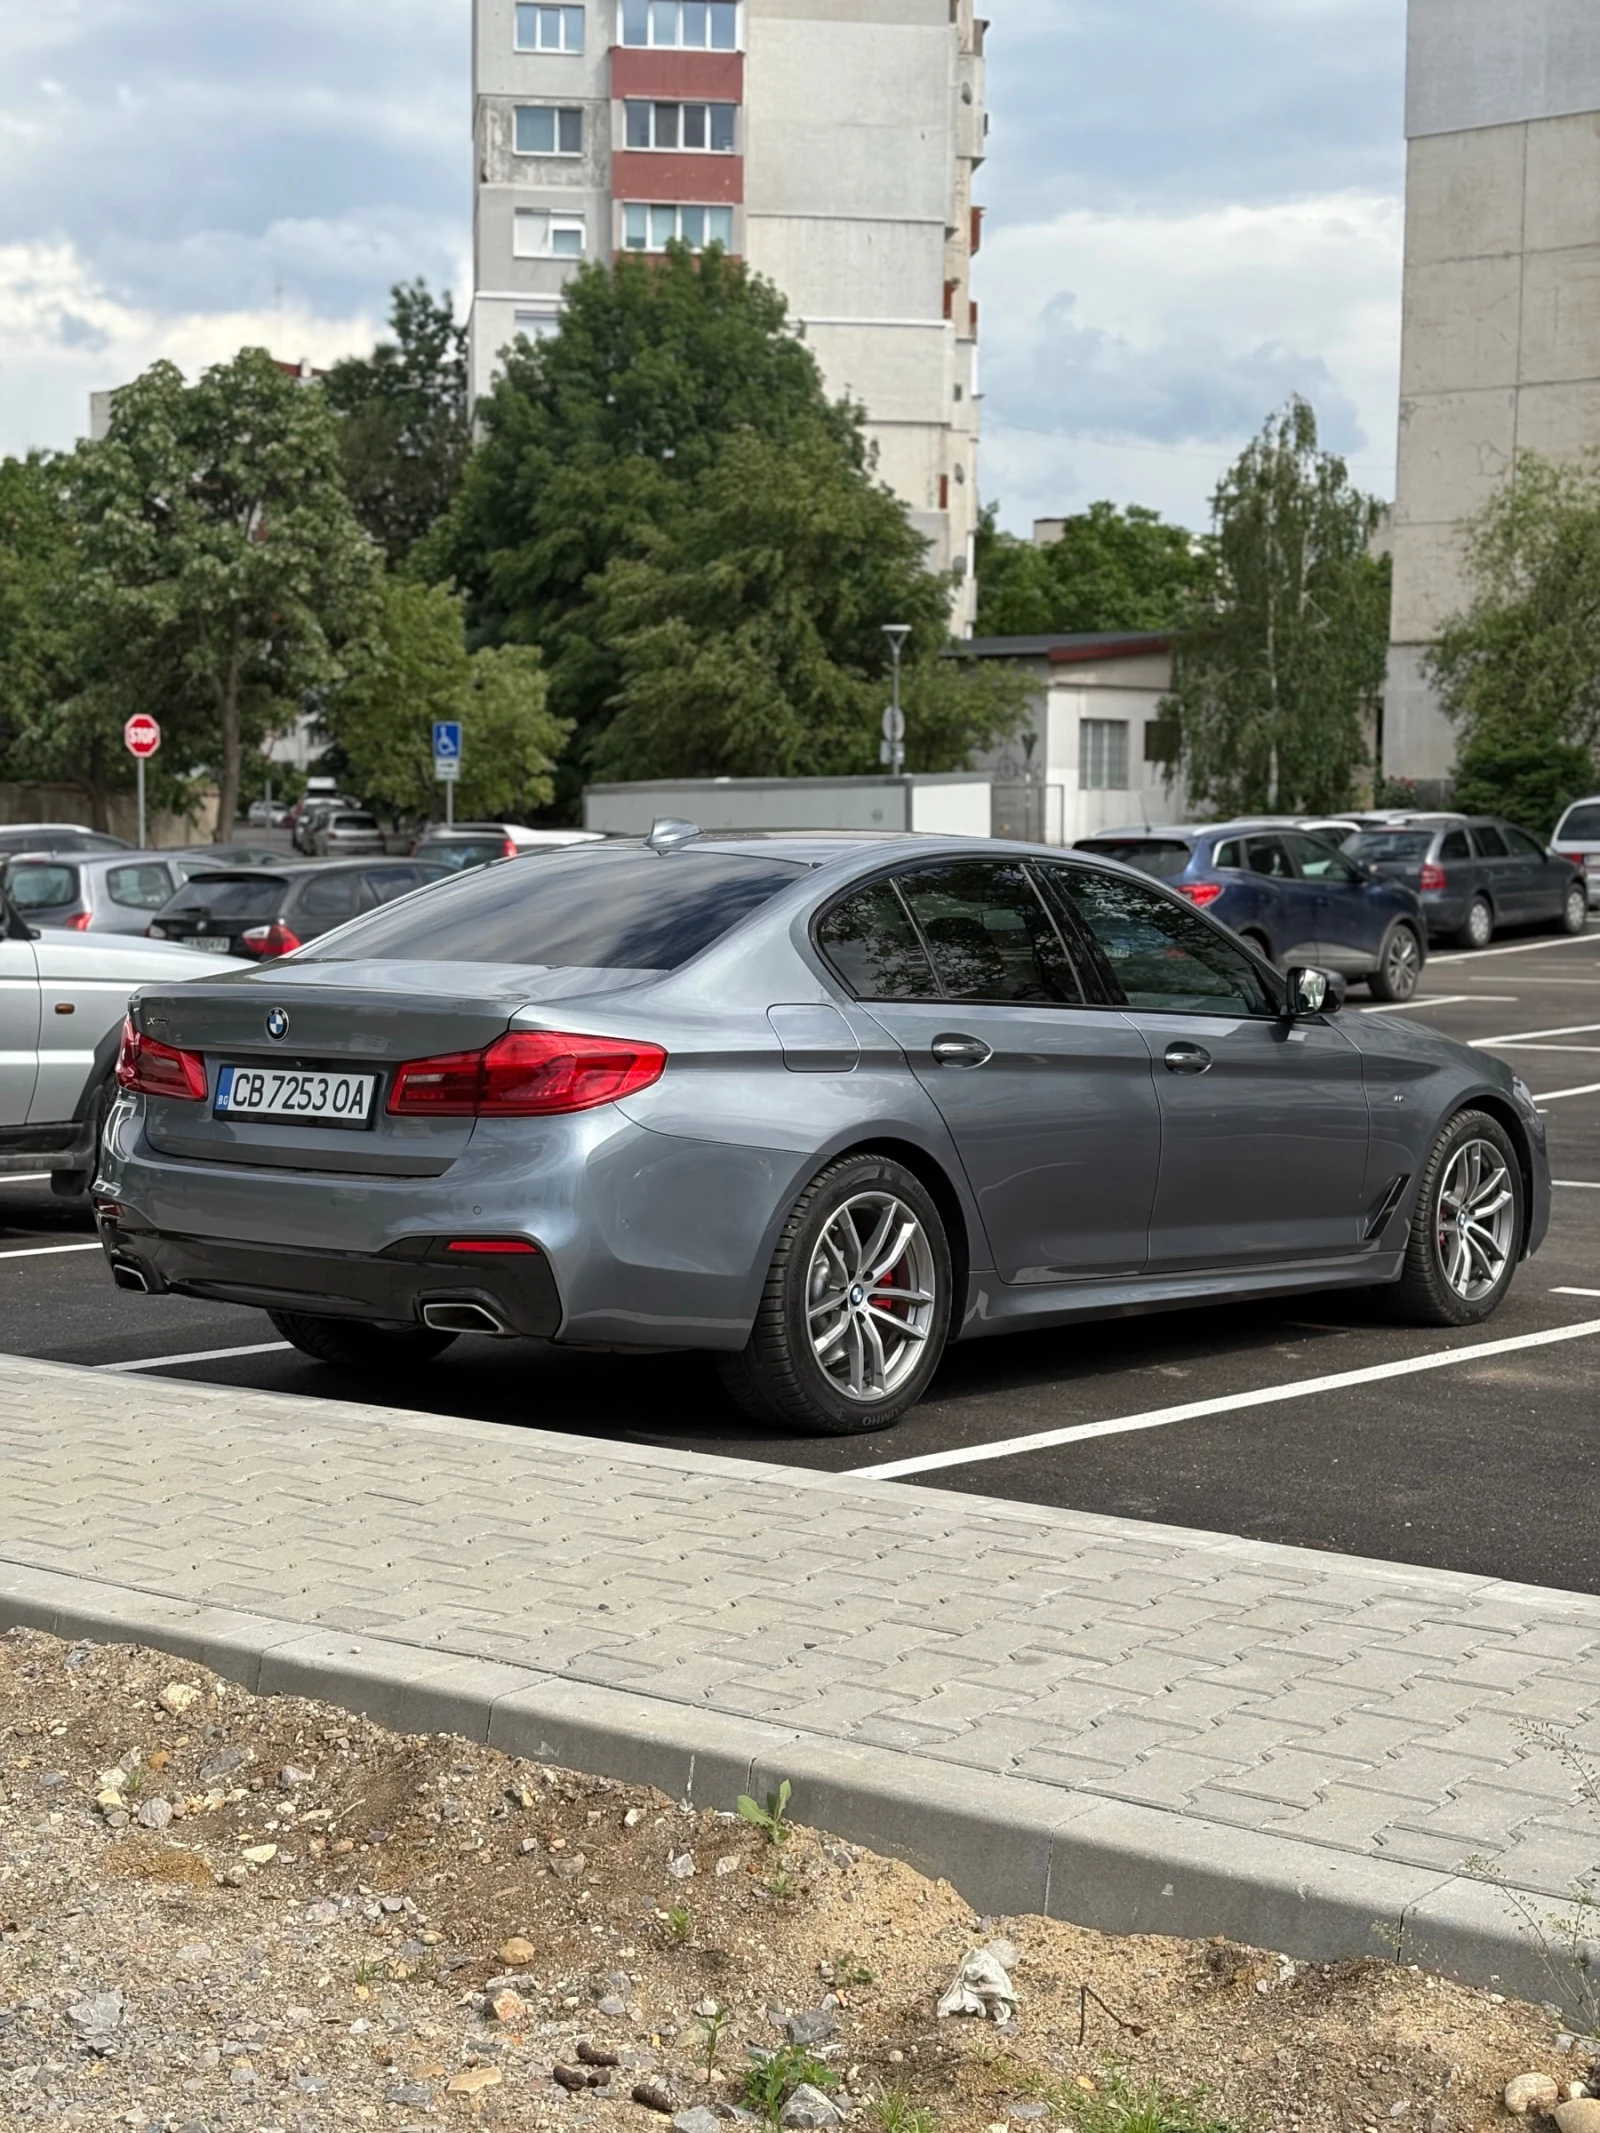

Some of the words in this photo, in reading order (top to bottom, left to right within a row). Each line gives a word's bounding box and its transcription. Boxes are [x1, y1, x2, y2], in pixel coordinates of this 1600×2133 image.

[129, 727, 156, 744] STOP
[218, 1094, 229, 1105] BG
[267, 1075, 329, 1111] 7253
